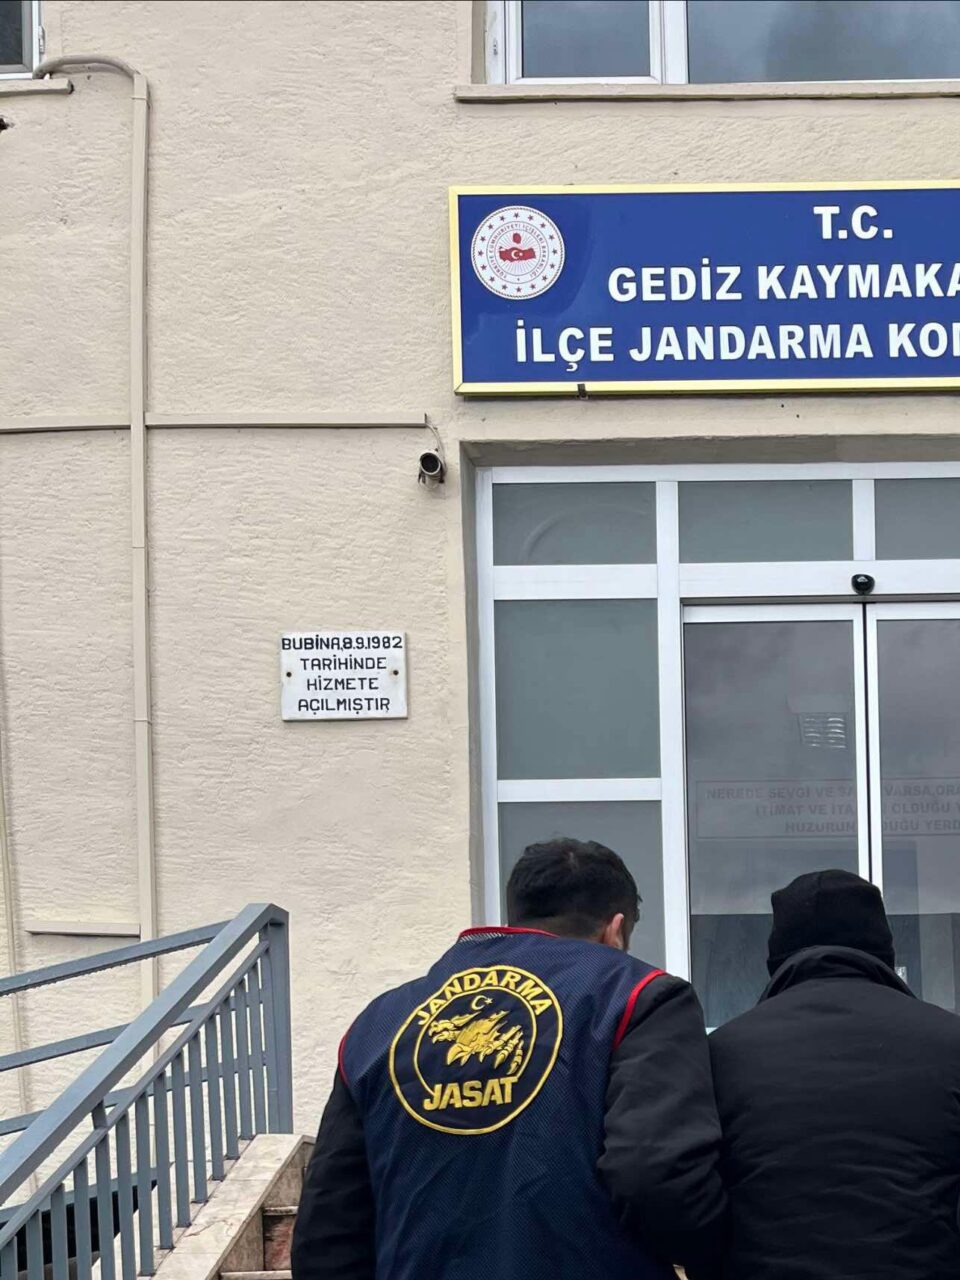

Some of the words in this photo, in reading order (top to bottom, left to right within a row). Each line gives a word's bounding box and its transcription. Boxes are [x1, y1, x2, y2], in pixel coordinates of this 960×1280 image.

[814, 205, 893, 240] T.C.
[608, 257, 742, 303] GEDİZ
[517, 319, 614, 372] İLÇE
[630, 323, 875, 362] JANDARMA
[300, 654, 387, 670] TARİHİNDE
[307, 675, 379, 691] HİZMETE
[298, 698, 390, 715] AÇILMIŞTIR
[417, 971, 552, 1026] JANDARMA
[423, 1077, 518, 1111] JASAT
